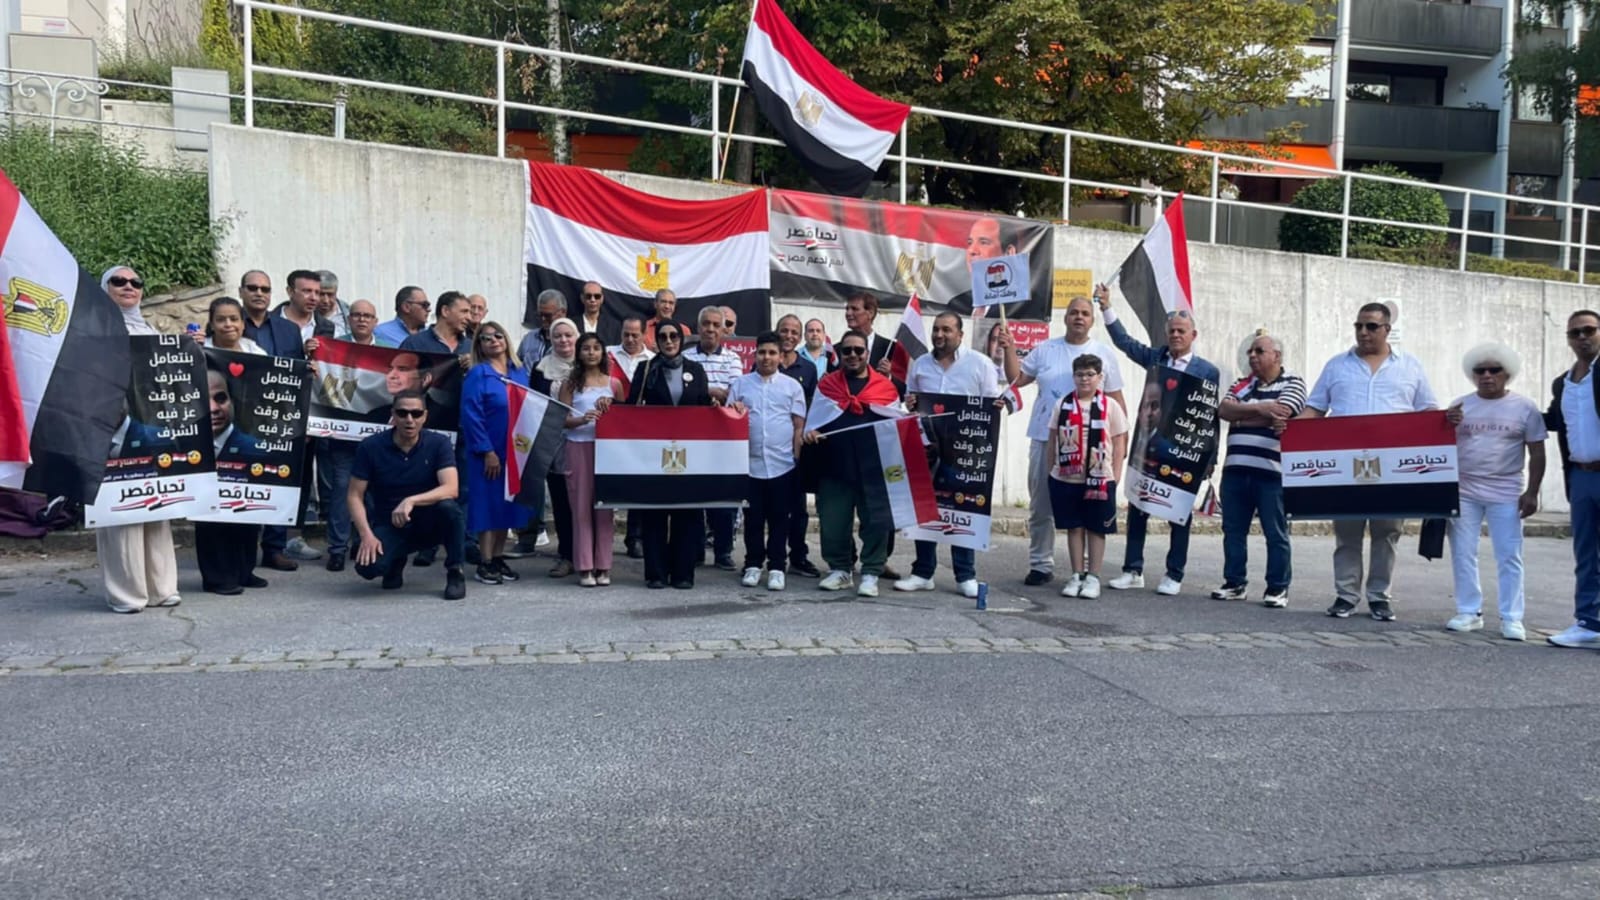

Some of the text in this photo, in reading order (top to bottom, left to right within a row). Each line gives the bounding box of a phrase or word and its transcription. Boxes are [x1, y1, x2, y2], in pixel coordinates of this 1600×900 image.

[786, 226, 838, 241] تحيا مصر
[159, 335, 181, 349] إحنا
[149, 352, 194, 367] بنتعامل
[273, 356, 294, 373] إحنا
[154, 369, 192, 385] بشرف
[260, 371, 302, 390] بنتعامل
[148, 390, 176, 403] وقت
[262, 389, 297, 406] بشرف
[156, 407, 196, 422] عز فيه
[254, 405, 279, 419] وقت
[957, 410, 991, 425] بنتعامل
[1185, 407, 1215, 424] بشرف
[156, 423, 199, 440] الشرف
[257, 422, 294, 437] عز فيه
[330, 422, 350, 433] تحيا
[1174, 417, 1196, 433] وقت
[1463, 424, 1510, 432] HILFIGER
[959, 426, 988, 440] بشرف
[254, 440, 293, 453] الشرف
[953, 440, 974, 453] وقت
[1174, 433, 1205, 449] عز فيه
[1168, 446, 1201, 463] الشرف
[1398, 454, 1447, 468] تحيا مصر
[957, 456, 987, 469] عز فيه
[1291, 459, 1336, 471] تحيا مصر
[955, 471, 987, 484] الشرف
[119, 480, 185, 503] تحيا مصر
[218, 485, 271, 504] تحيا مص
[1148, 481, 1172, 499] تحيا
[951, 512, 971, 528] تحيا
